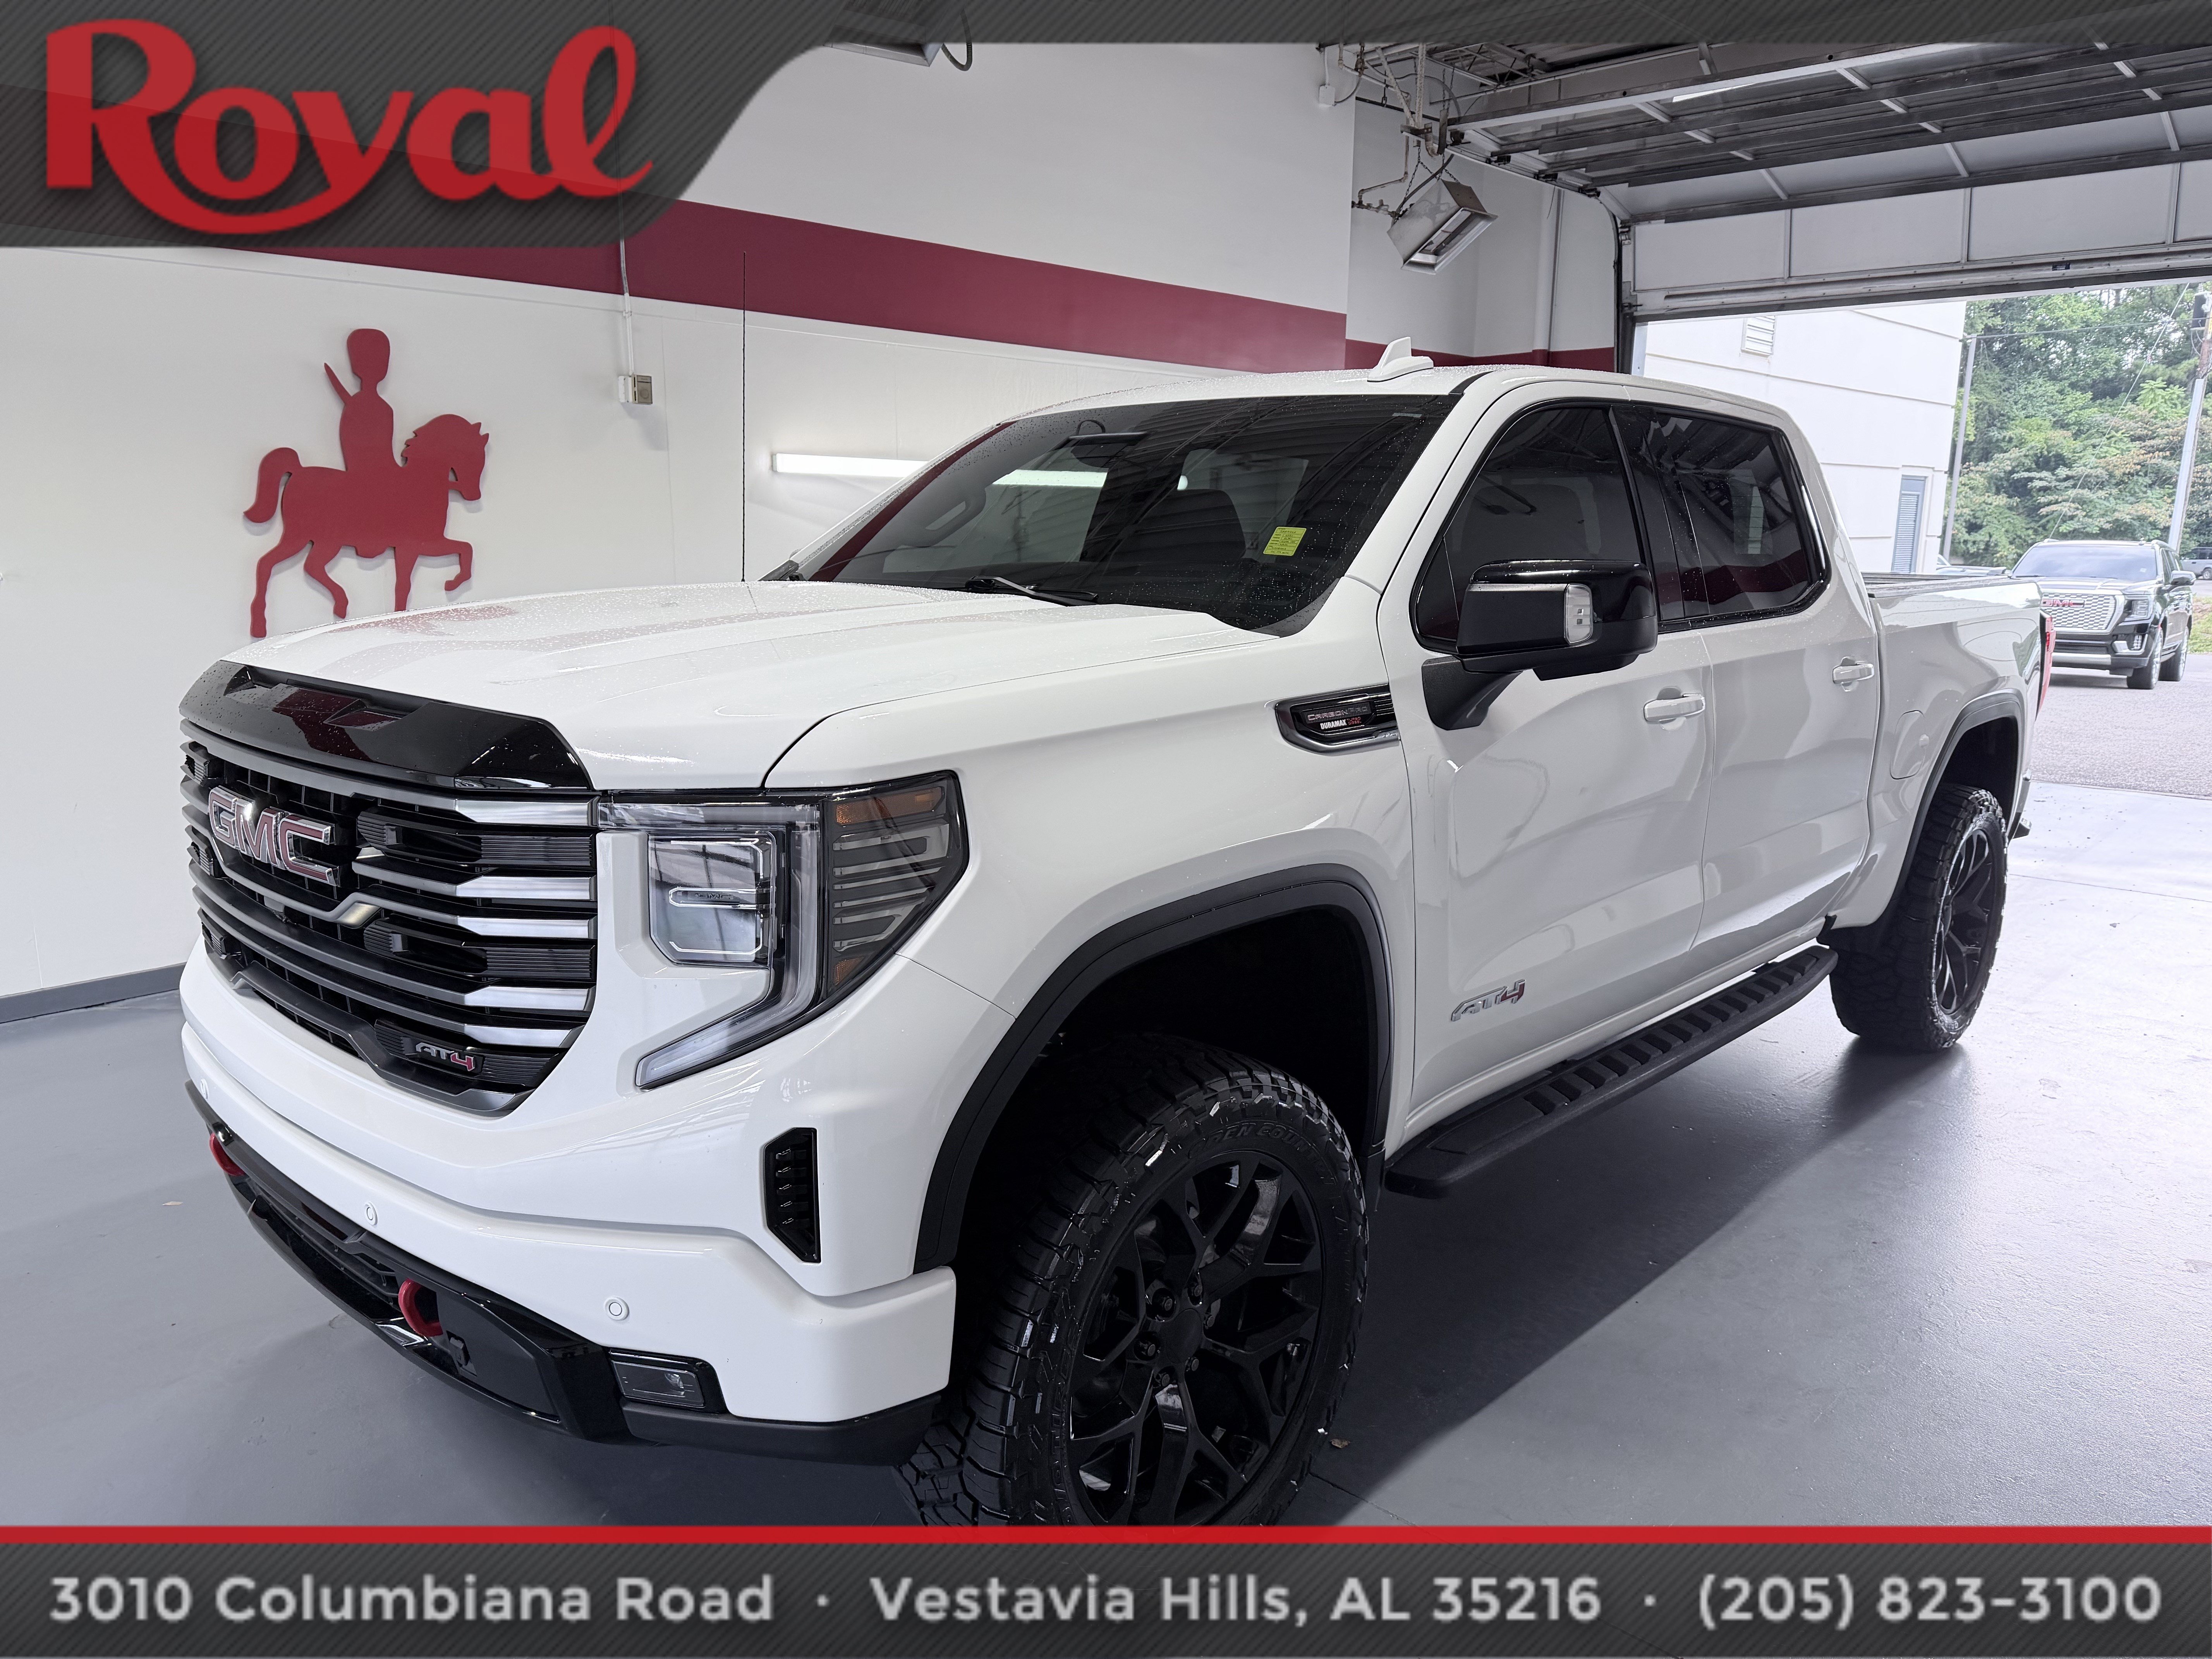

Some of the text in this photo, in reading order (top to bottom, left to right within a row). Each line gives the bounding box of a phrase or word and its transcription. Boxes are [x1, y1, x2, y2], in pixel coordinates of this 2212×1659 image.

[1320, 719, 1347, 729] DURAMAX
[208, 787, 341, 886] GMC
[1451, 979, 1526, 1022] AT4
[416, 1042, 475, 1072] AT4
